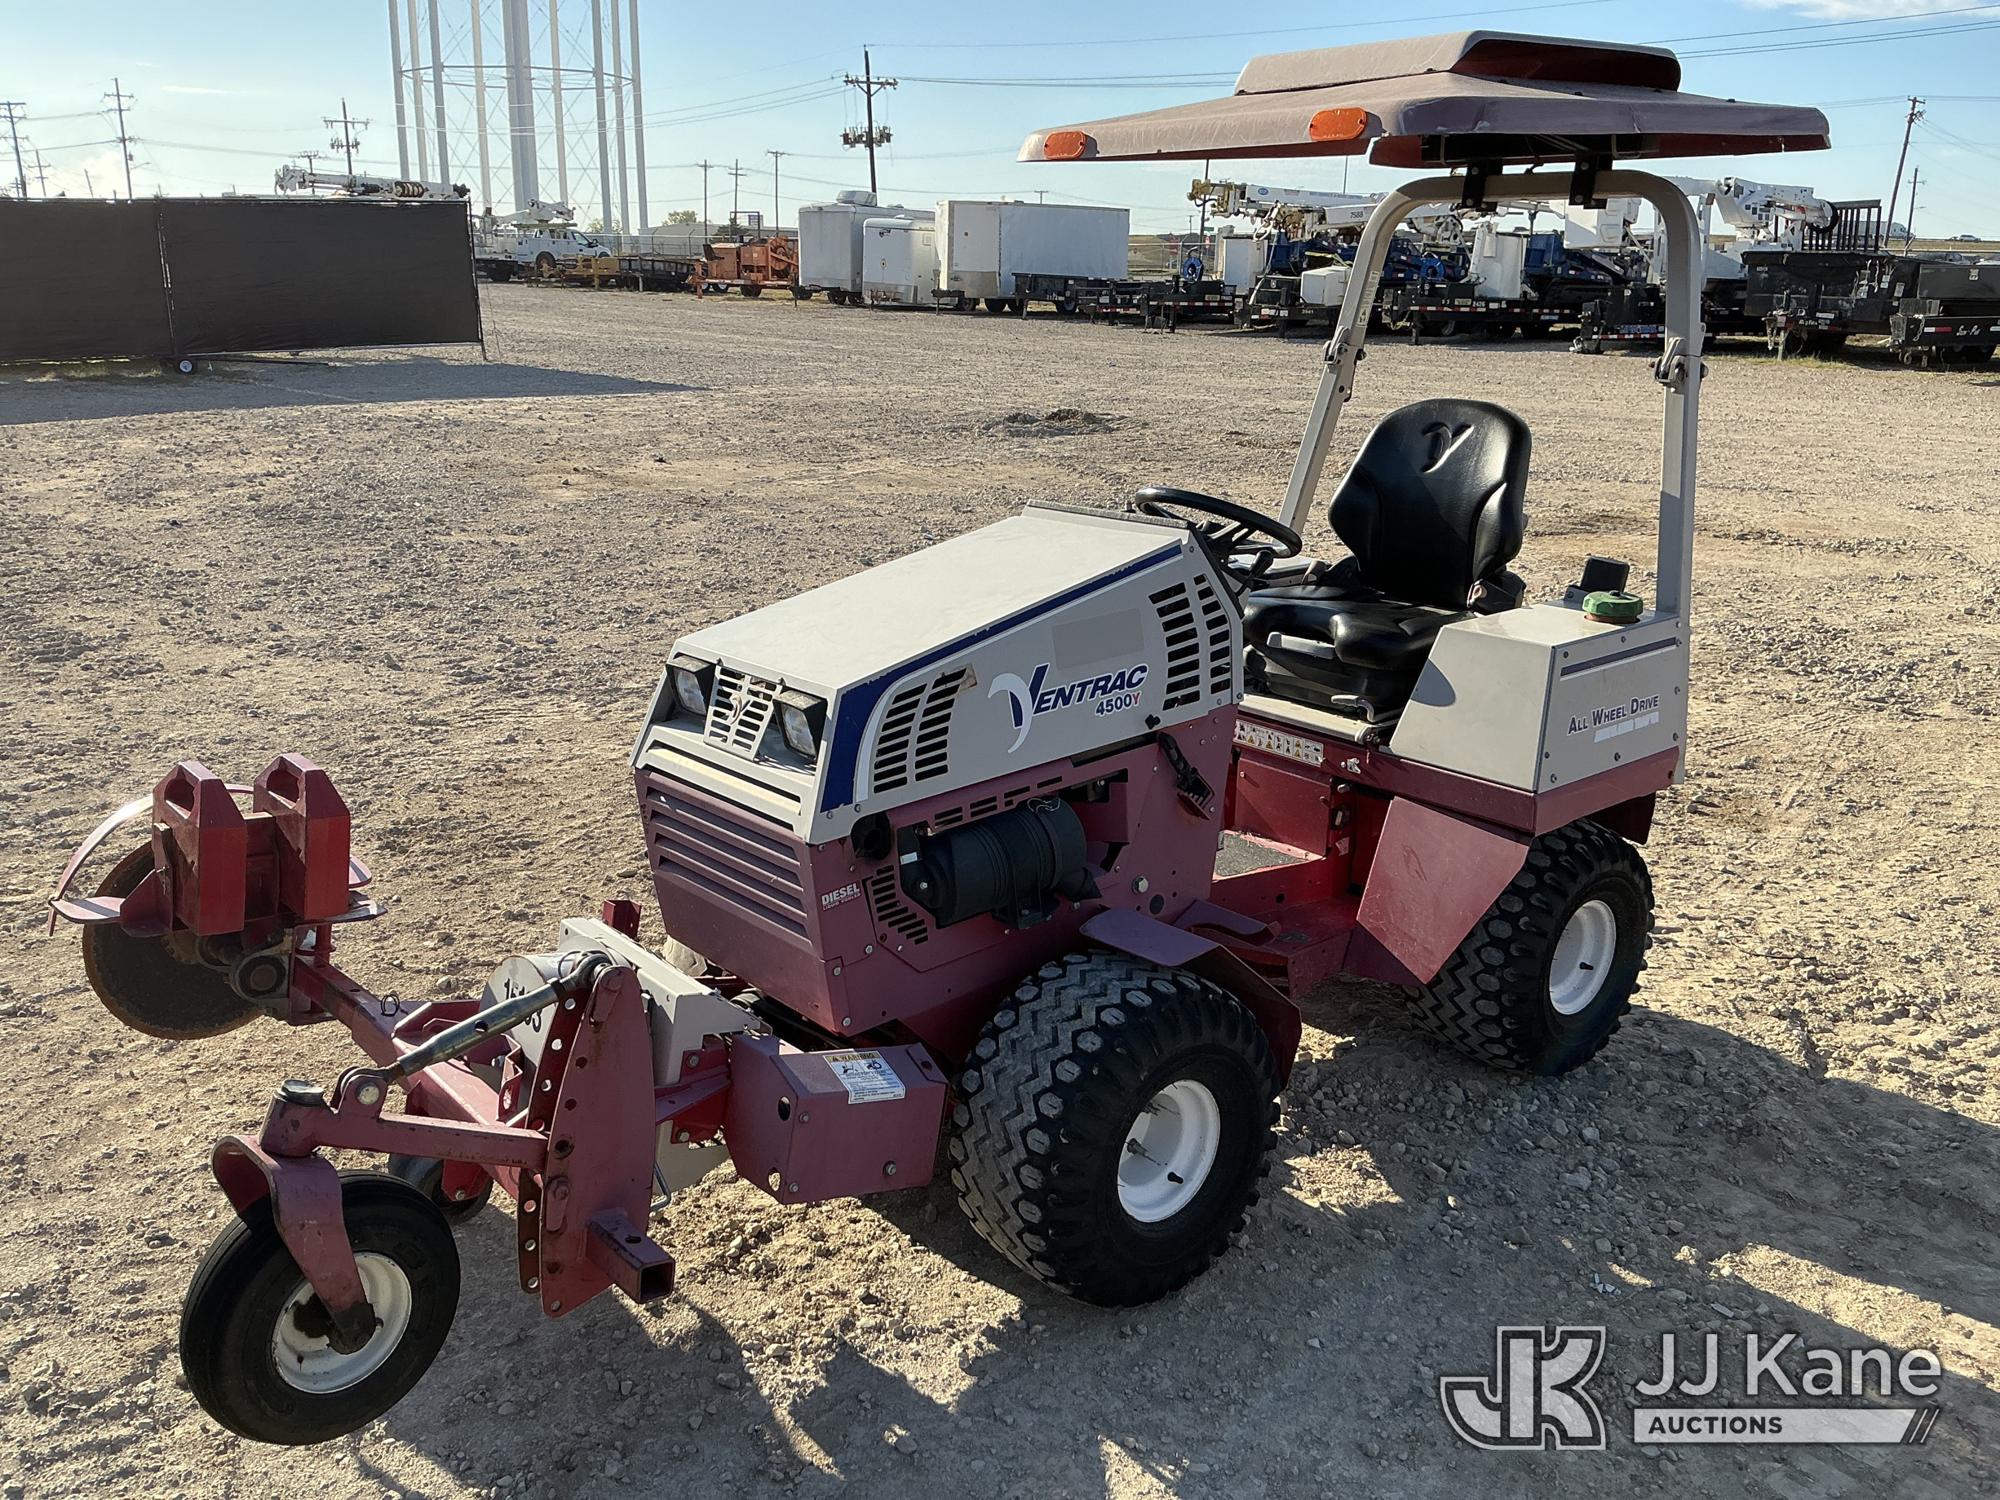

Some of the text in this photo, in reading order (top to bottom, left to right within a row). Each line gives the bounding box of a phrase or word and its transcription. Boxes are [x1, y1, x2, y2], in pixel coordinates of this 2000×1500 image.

[990, 663, 1148, 750] VENTRAC
[1095, 692, 1142, 716] 4500Y
[821, 883, 860, 905] DIESEL
